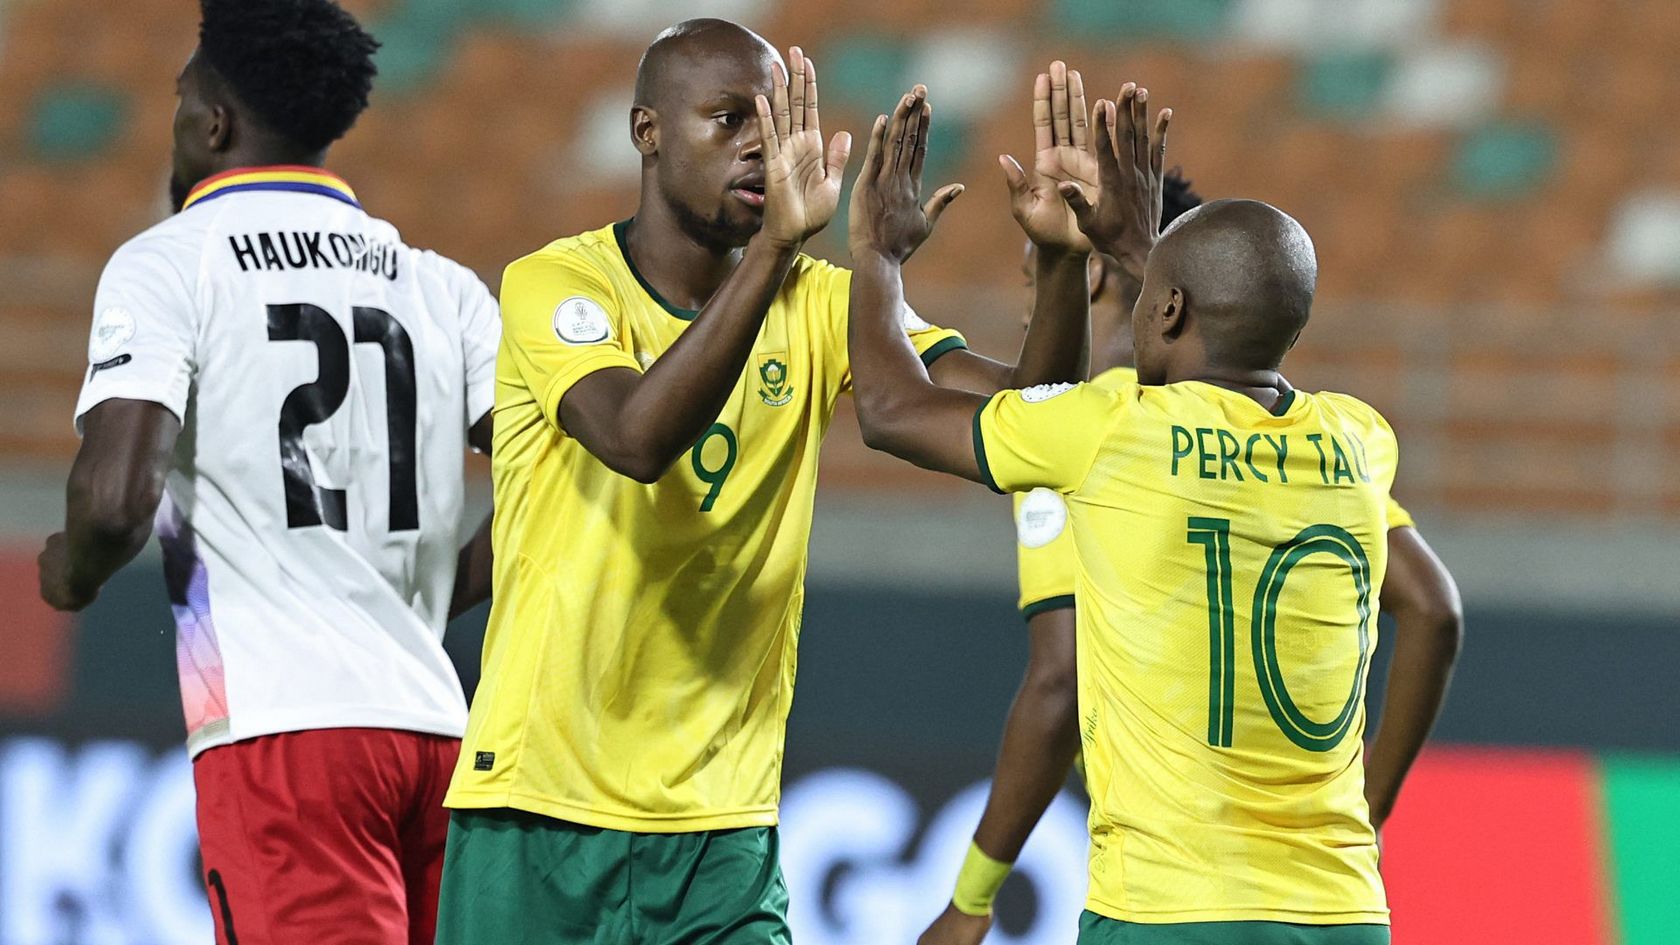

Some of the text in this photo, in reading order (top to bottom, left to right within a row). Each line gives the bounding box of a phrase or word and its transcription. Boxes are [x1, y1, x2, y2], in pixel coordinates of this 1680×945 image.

[266, 303, 419, 532] 21
[691, 422, 738, 513] 9
[1171, 425, 1371, 485] PERCY TAU
[1187, 516, 1371, 752] 10
